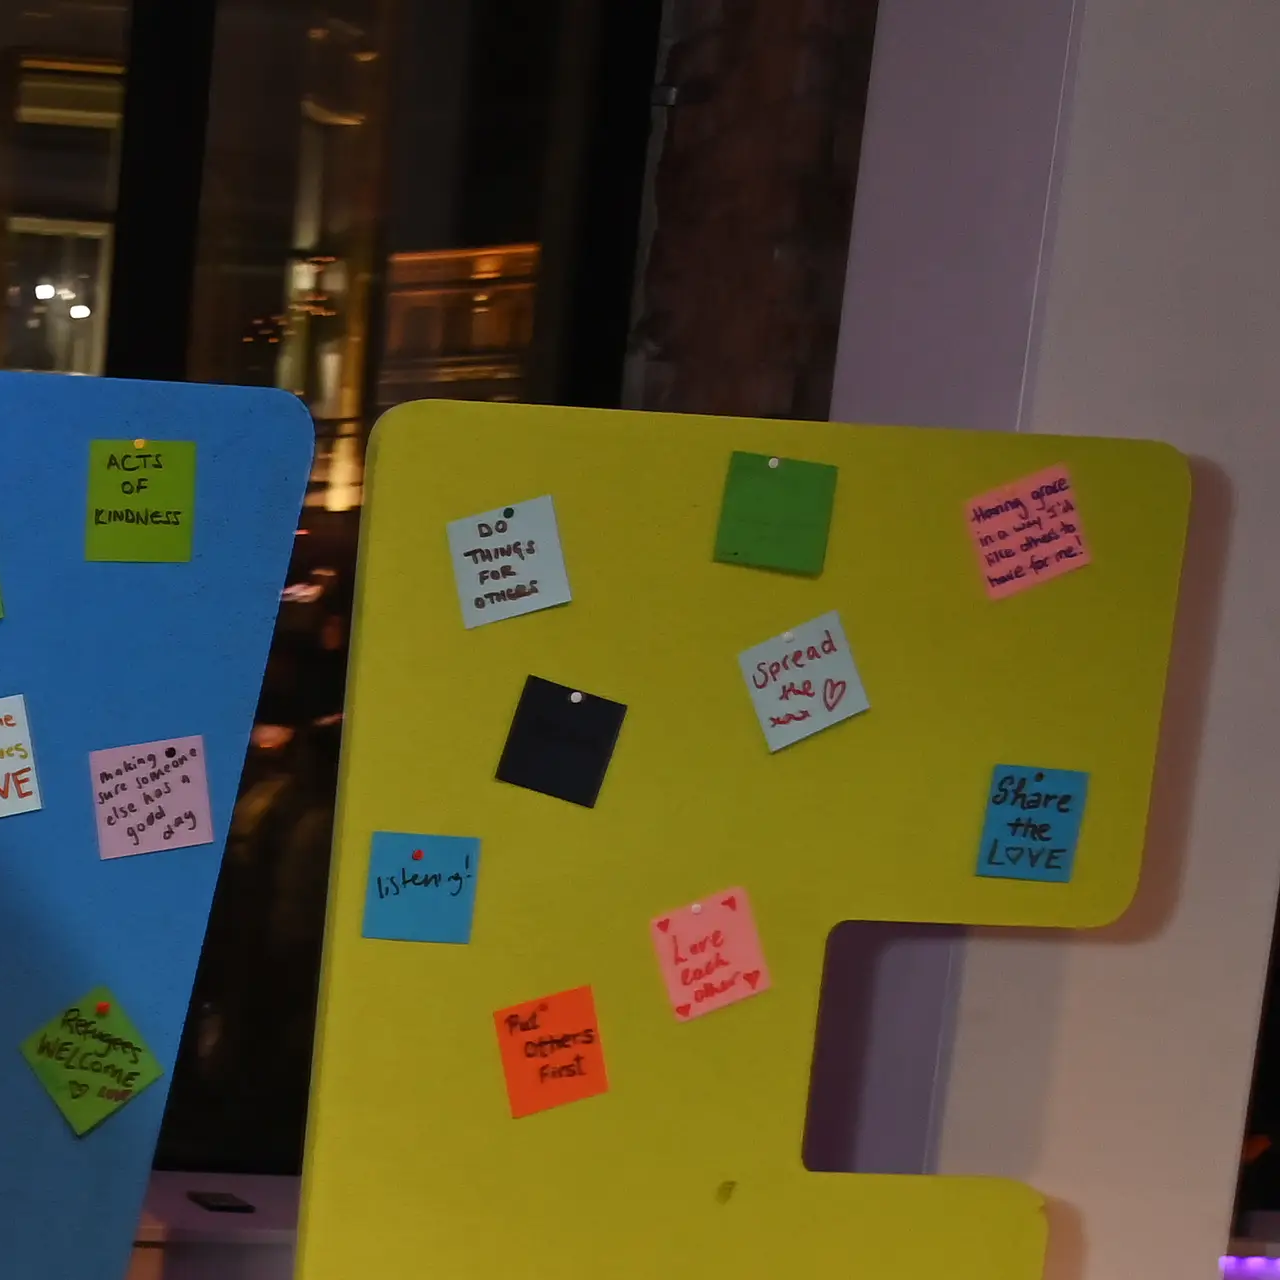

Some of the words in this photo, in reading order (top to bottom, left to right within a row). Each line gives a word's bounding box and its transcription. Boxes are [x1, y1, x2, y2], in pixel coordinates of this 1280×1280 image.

[106, 453, 164, 472] ACTS
[120, 477, 148, 495] OF
[94, 507, 181, 527] KINDNESS
[477, 520, 508, 538] DO
[1060, 520, 1077, 535] to
[977, 530, 995, 547] in
[997, 529, 1010, 541] a
[463, 539, 536, 565] THINGS
[1028, 554, 1050, 575] for
[478, 564, 517, 586] FOR
[474, 579, 539, 609] OTHERS
[752, 629, 838, 690] Spread
[135, 747, 198, 790] someone
[106, 802, 138, 826] else
[142, 781, 172, 806] has
[181, 774, 191, 784] a
[991, 774, 1072, 814] Share
[126, 805, 166, 846] good
[162, 810, 198, 841] day
[1007, 816, 1052, 842] the
